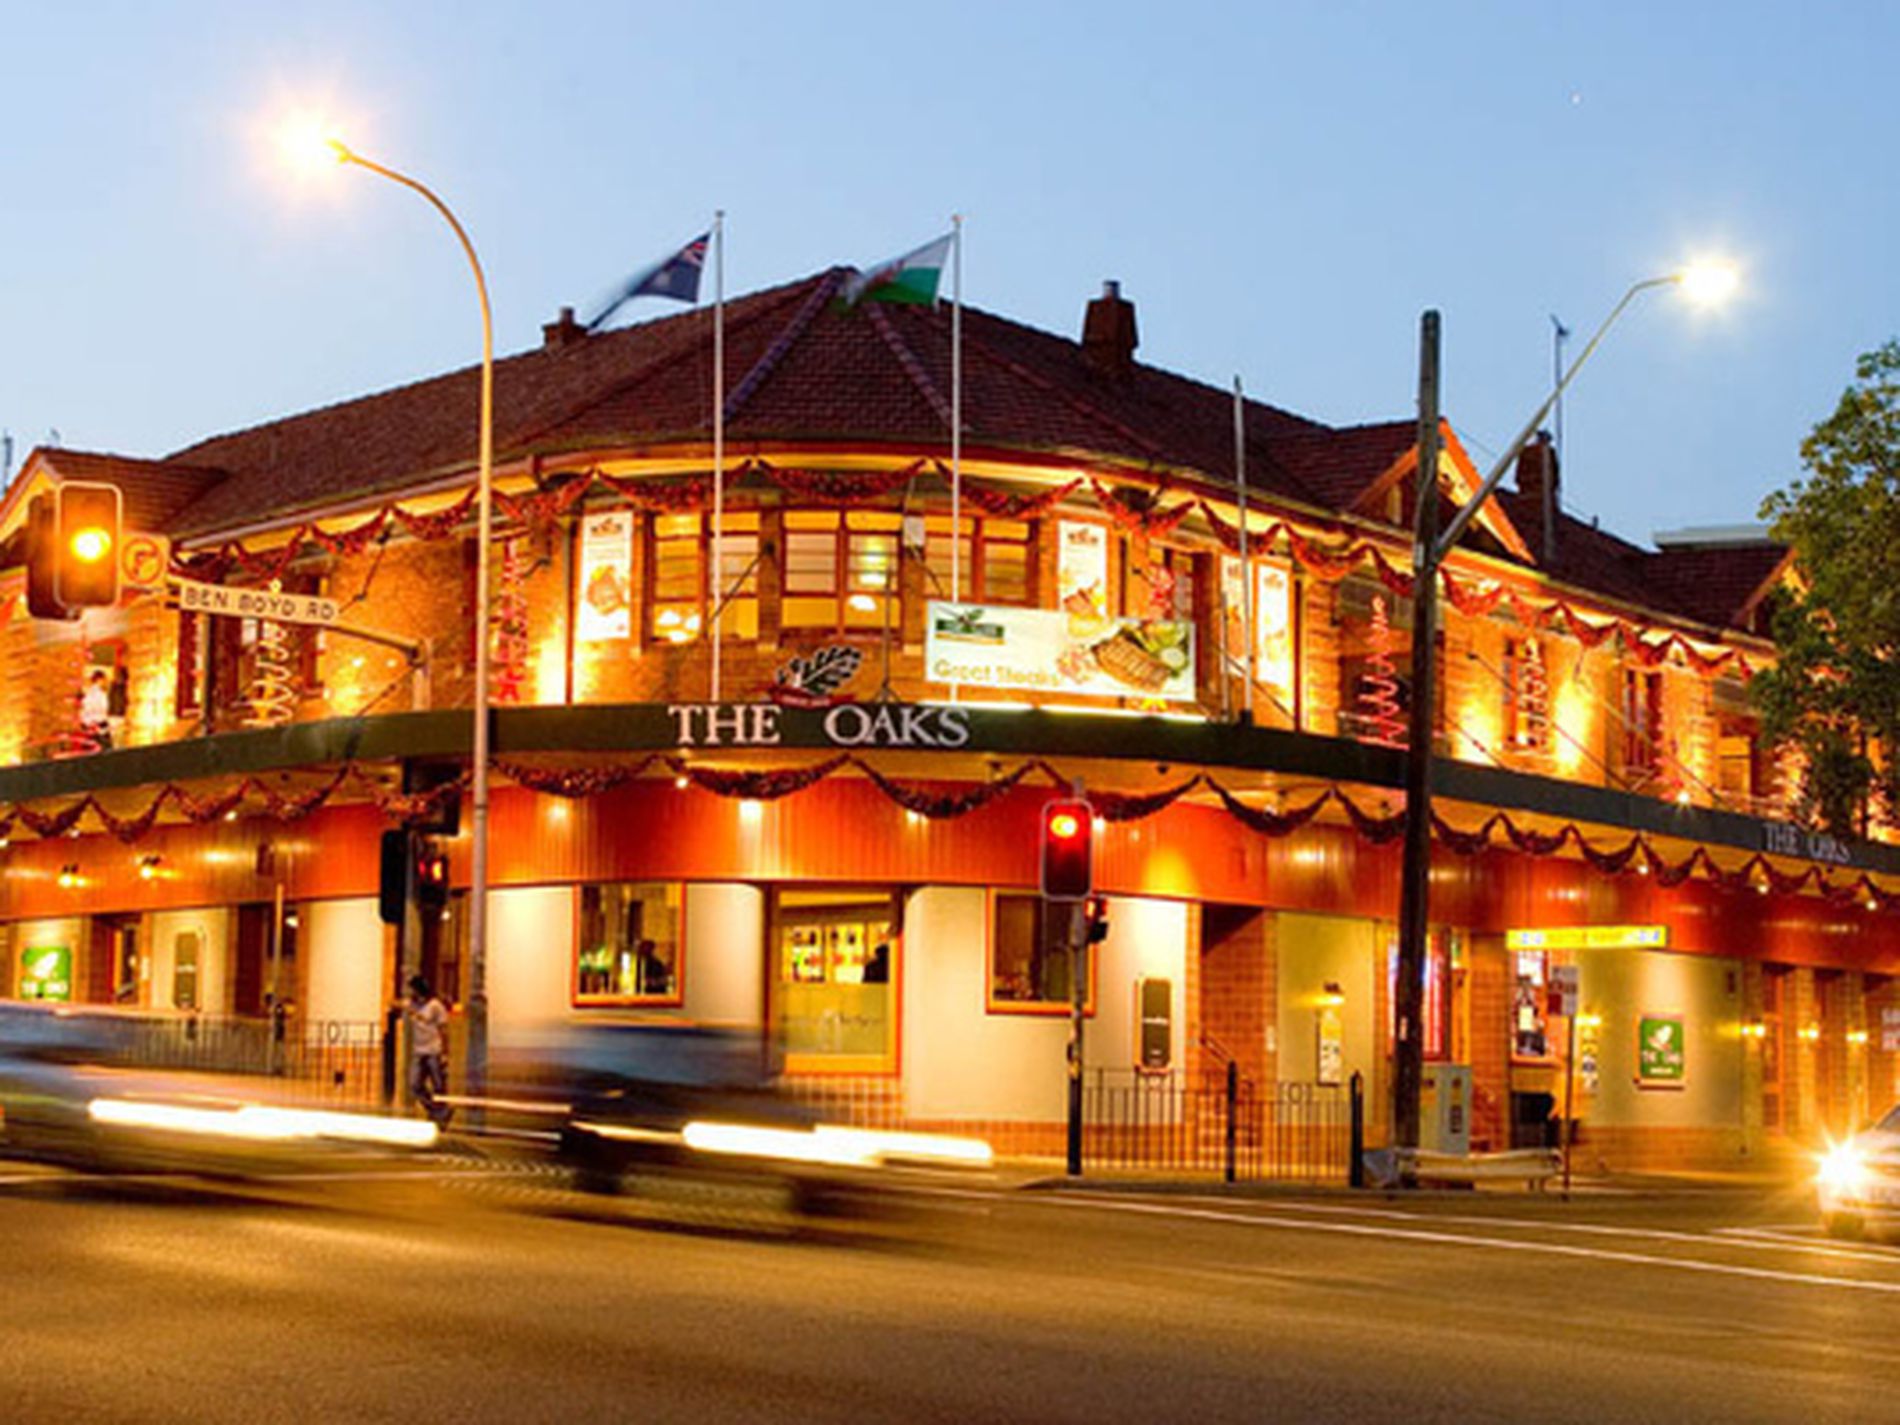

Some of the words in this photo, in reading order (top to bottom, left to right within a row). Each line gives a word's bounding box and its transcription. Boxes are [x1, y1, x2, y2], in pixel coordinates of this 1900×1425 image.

[184, 586, 229, 608] BEN
[237, 592, 296, 617] BOYD
[305, 601, 335, 621] RD
[667, 703, 783, 745] THE
[823, 704, 970, 748] OAKS
[1762, 821, 1799, 856] THE
